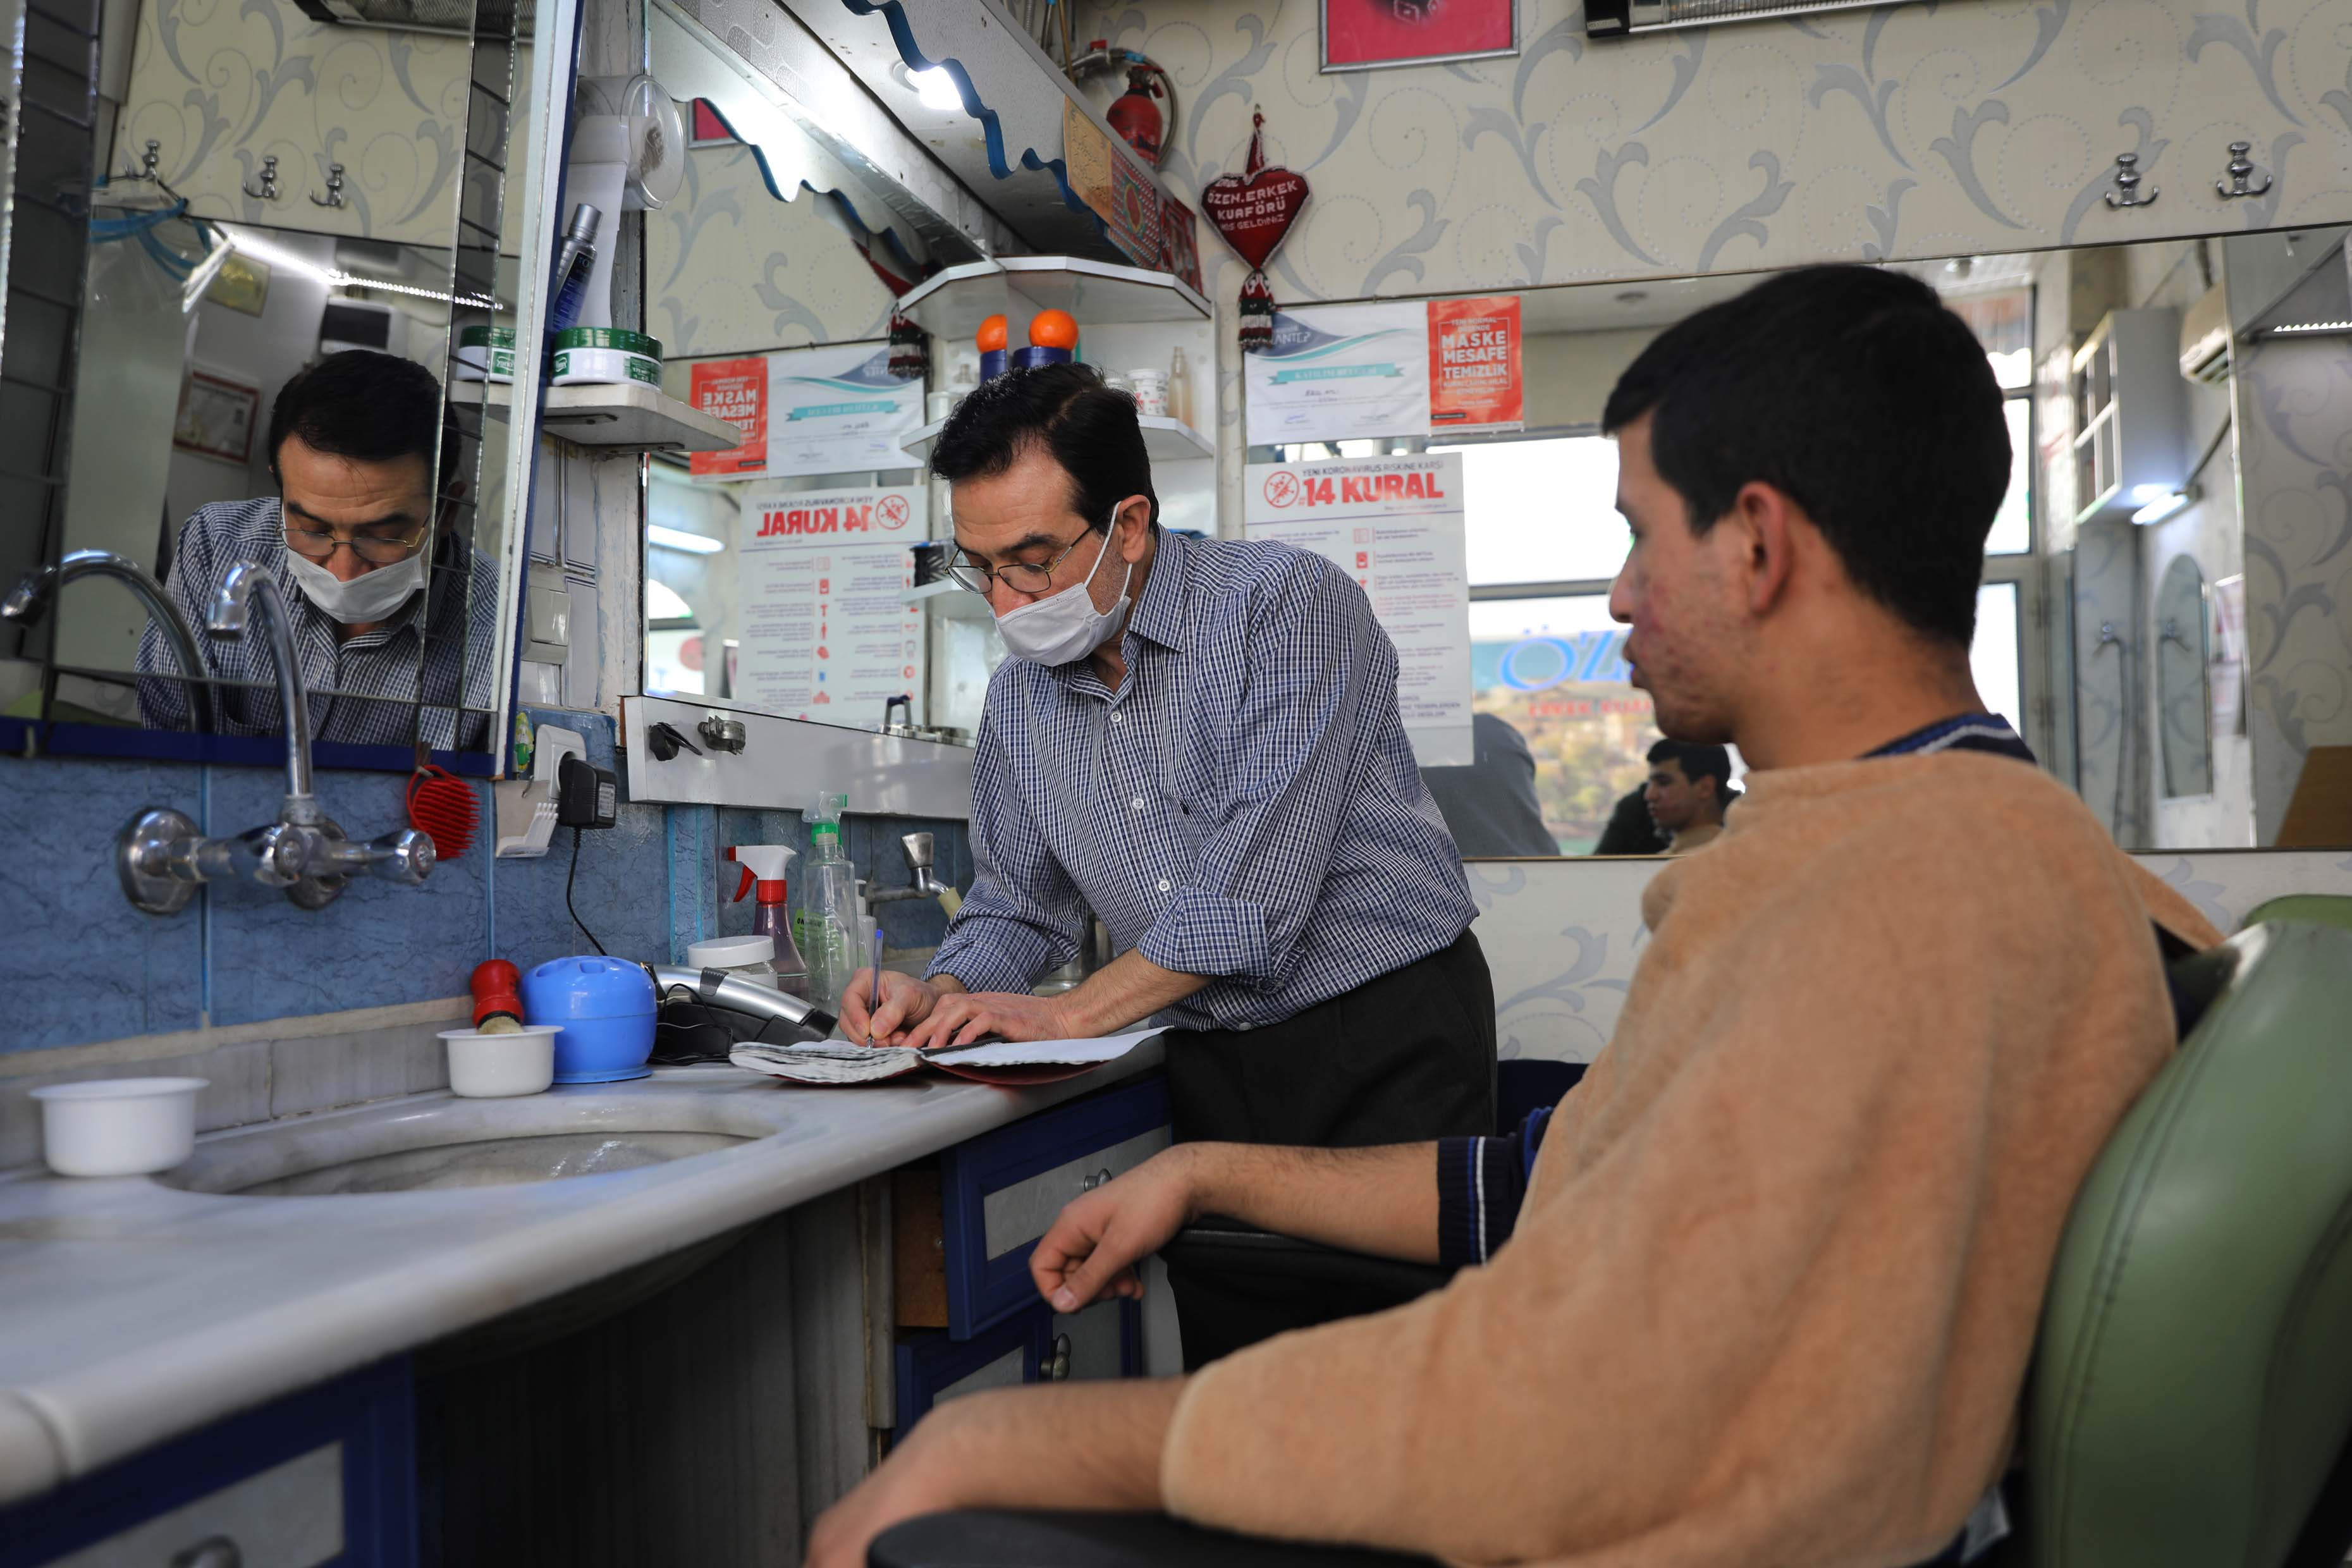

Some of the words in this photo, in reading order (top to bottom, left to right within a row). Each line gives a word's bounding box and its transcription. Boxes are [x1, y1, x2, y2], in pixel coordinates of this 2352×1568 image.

[1217, 197, 1286, 220] KUAFÖRÜ
[1441, 331, 1506, 349] MASKE
[1443, 346, 1507, 364] MESAFE
[1303, 477, 1336, 506] 14
[1341, 472, 1445, 504] KURAL
